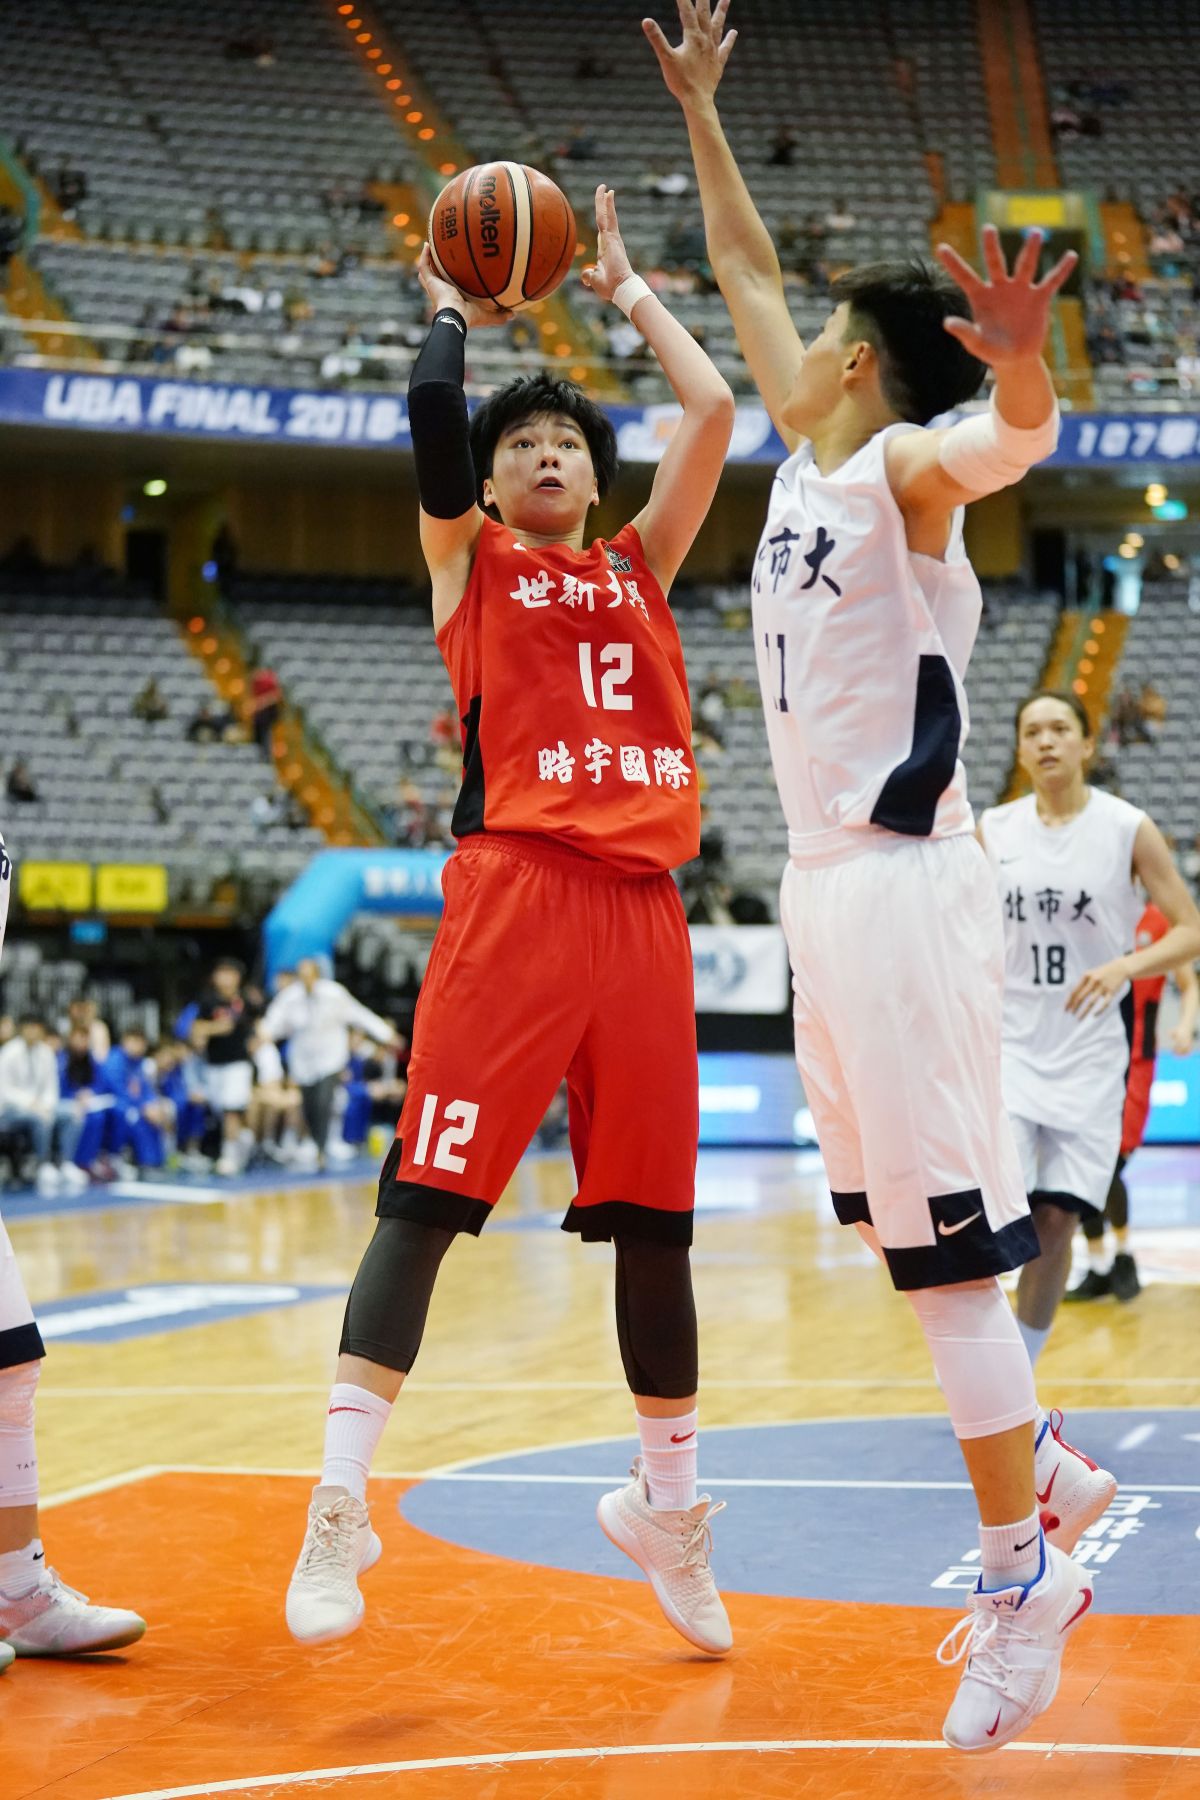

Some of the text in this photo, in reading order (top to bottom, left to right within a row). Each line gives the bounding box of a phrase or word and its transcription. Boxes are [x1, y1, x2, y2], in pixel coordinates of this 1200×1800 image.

[445, 206, 459, 239] FIBA
[478, 175, 501, 258] molten
[43, 376, 142, 425] UBA
[149, 382, 279, 433] FINAL
[578, 642, 633, 711] 12
[1005, 886, 1097, 926] 北市大
[1031, 944, 1066, 985] 18
[413, 1093, 480, 1175] 12
